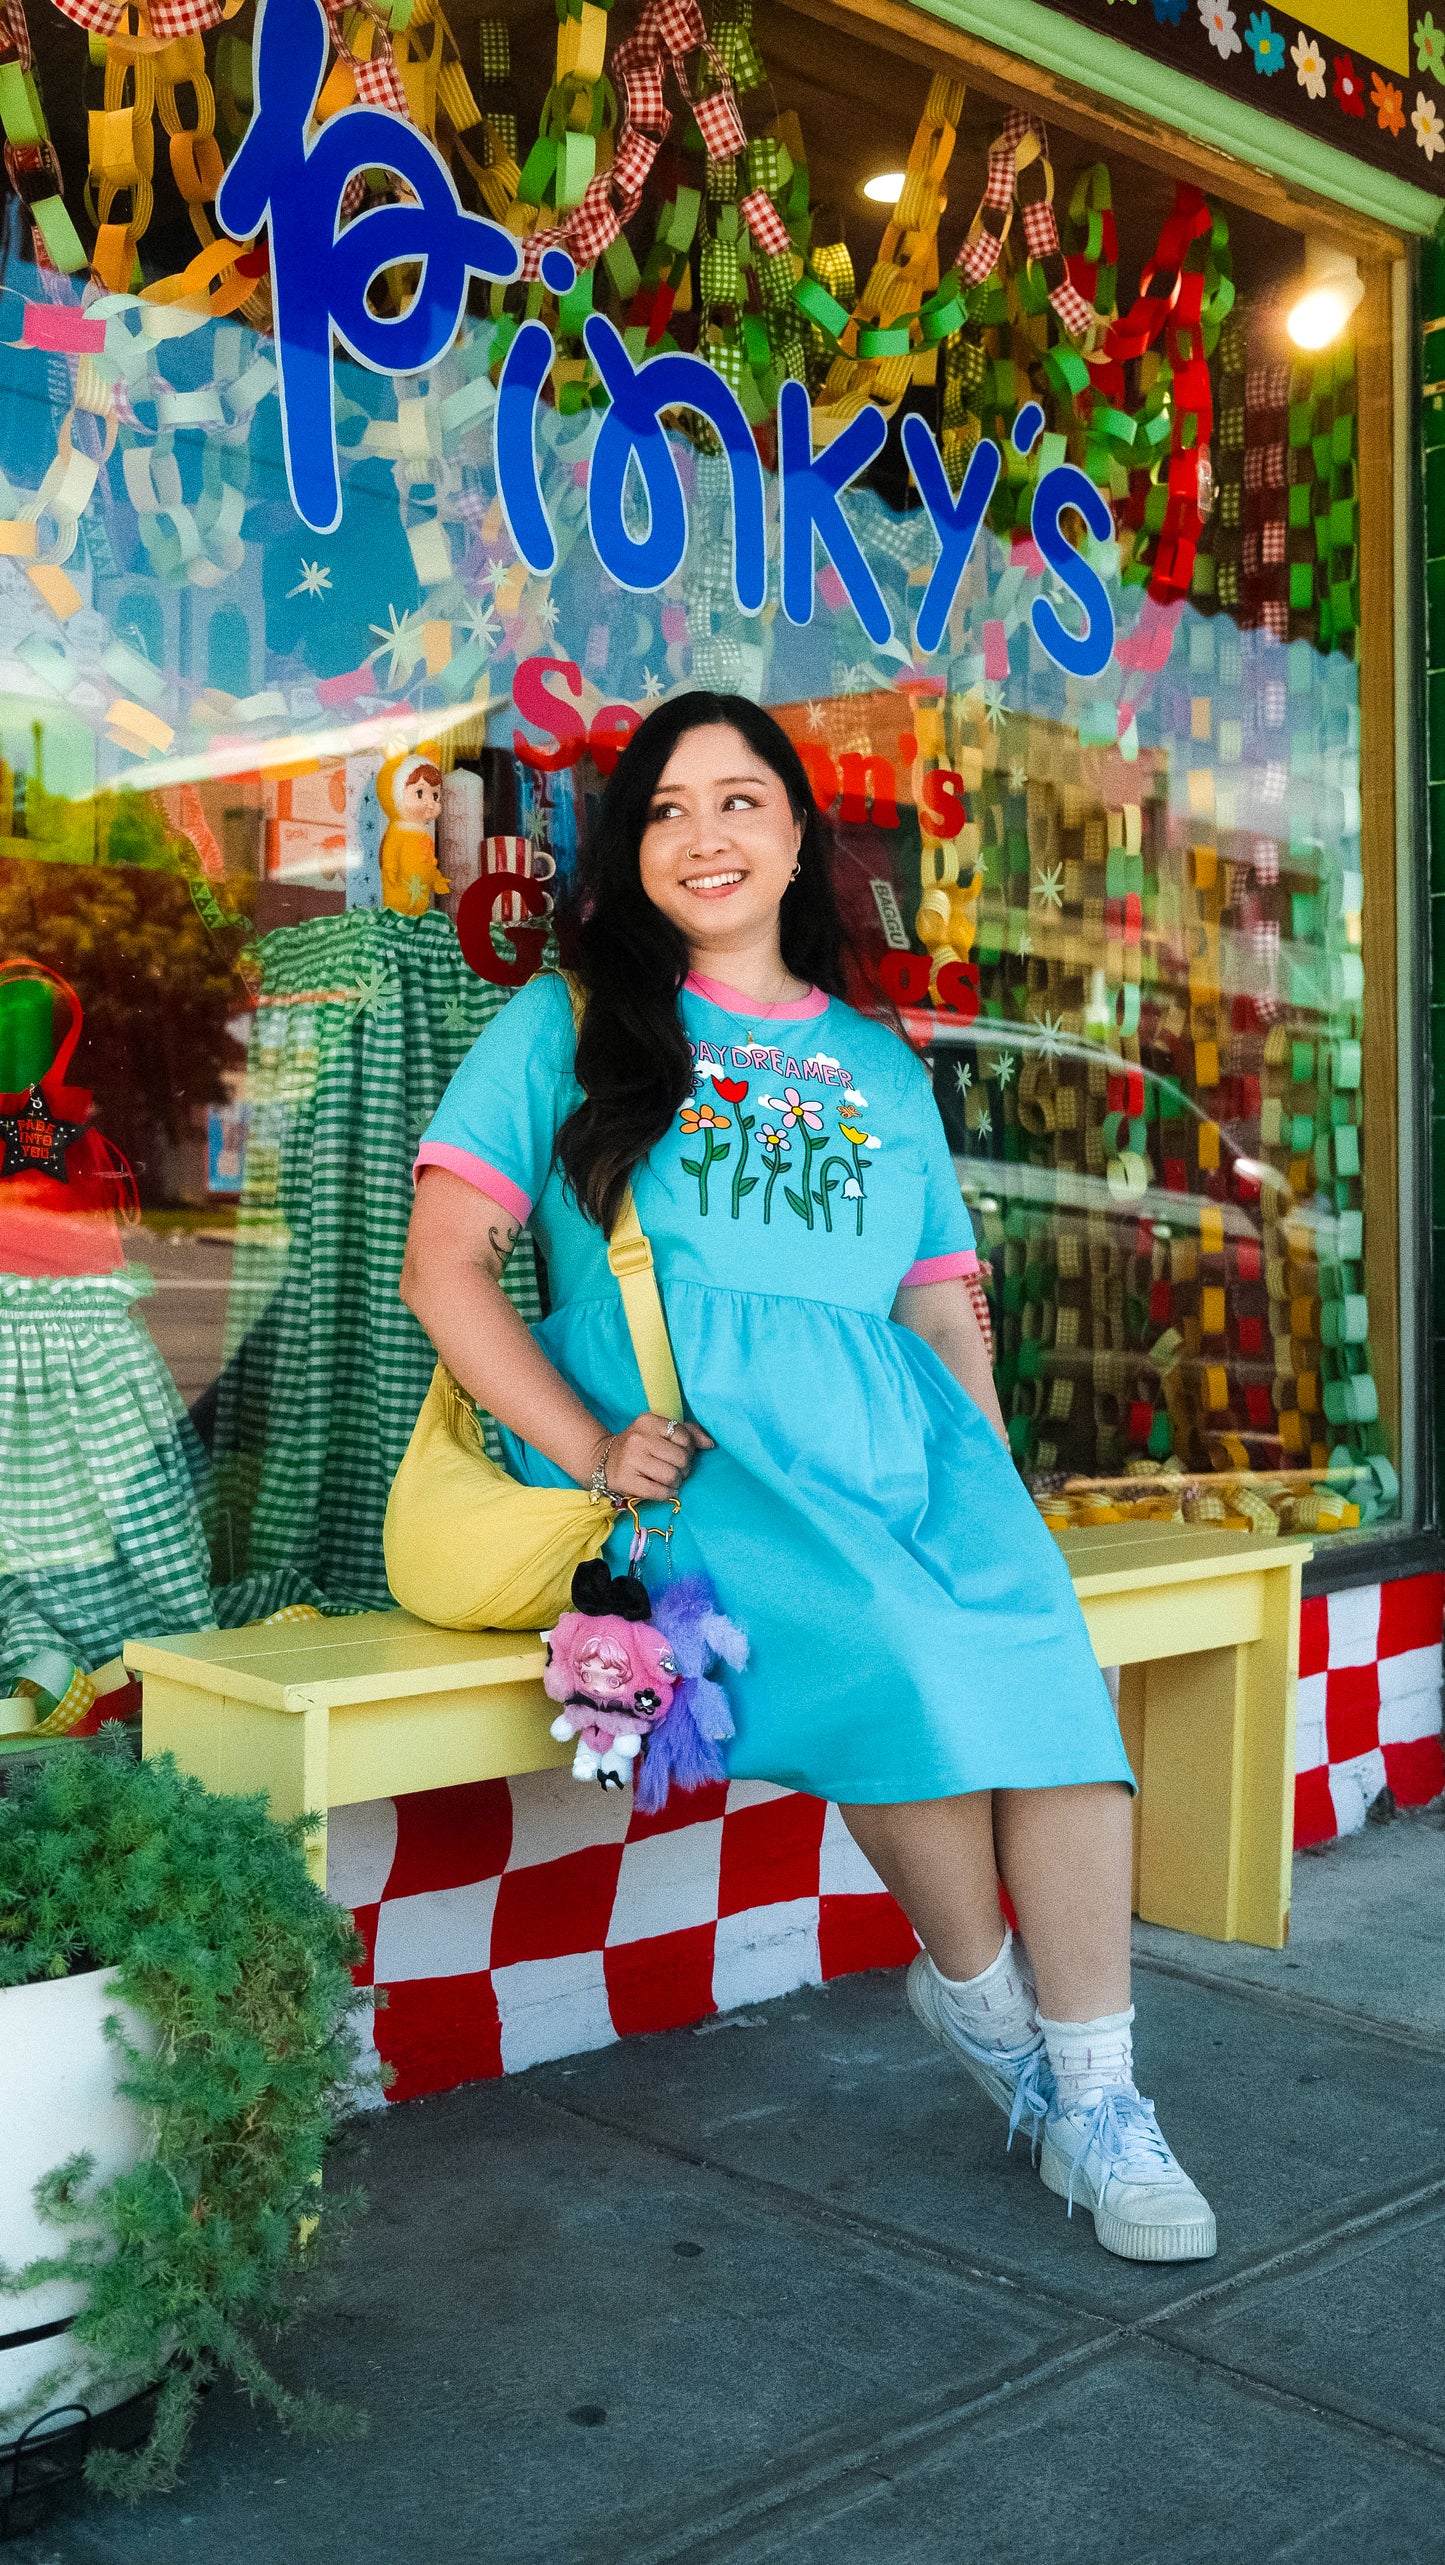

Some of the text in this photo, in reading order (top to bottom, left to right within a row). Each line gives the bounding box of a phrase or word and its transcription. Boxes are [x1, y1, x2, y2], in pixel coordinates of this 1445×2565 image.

[512, 656, 966, 839] Sen's
[875, 885, 905, 945] BAGGU
[17, 1119, 56, 1135] FADE
[19, 1131, 53, 1147] INTO
[21, 1144, 50, 1159] YOU
